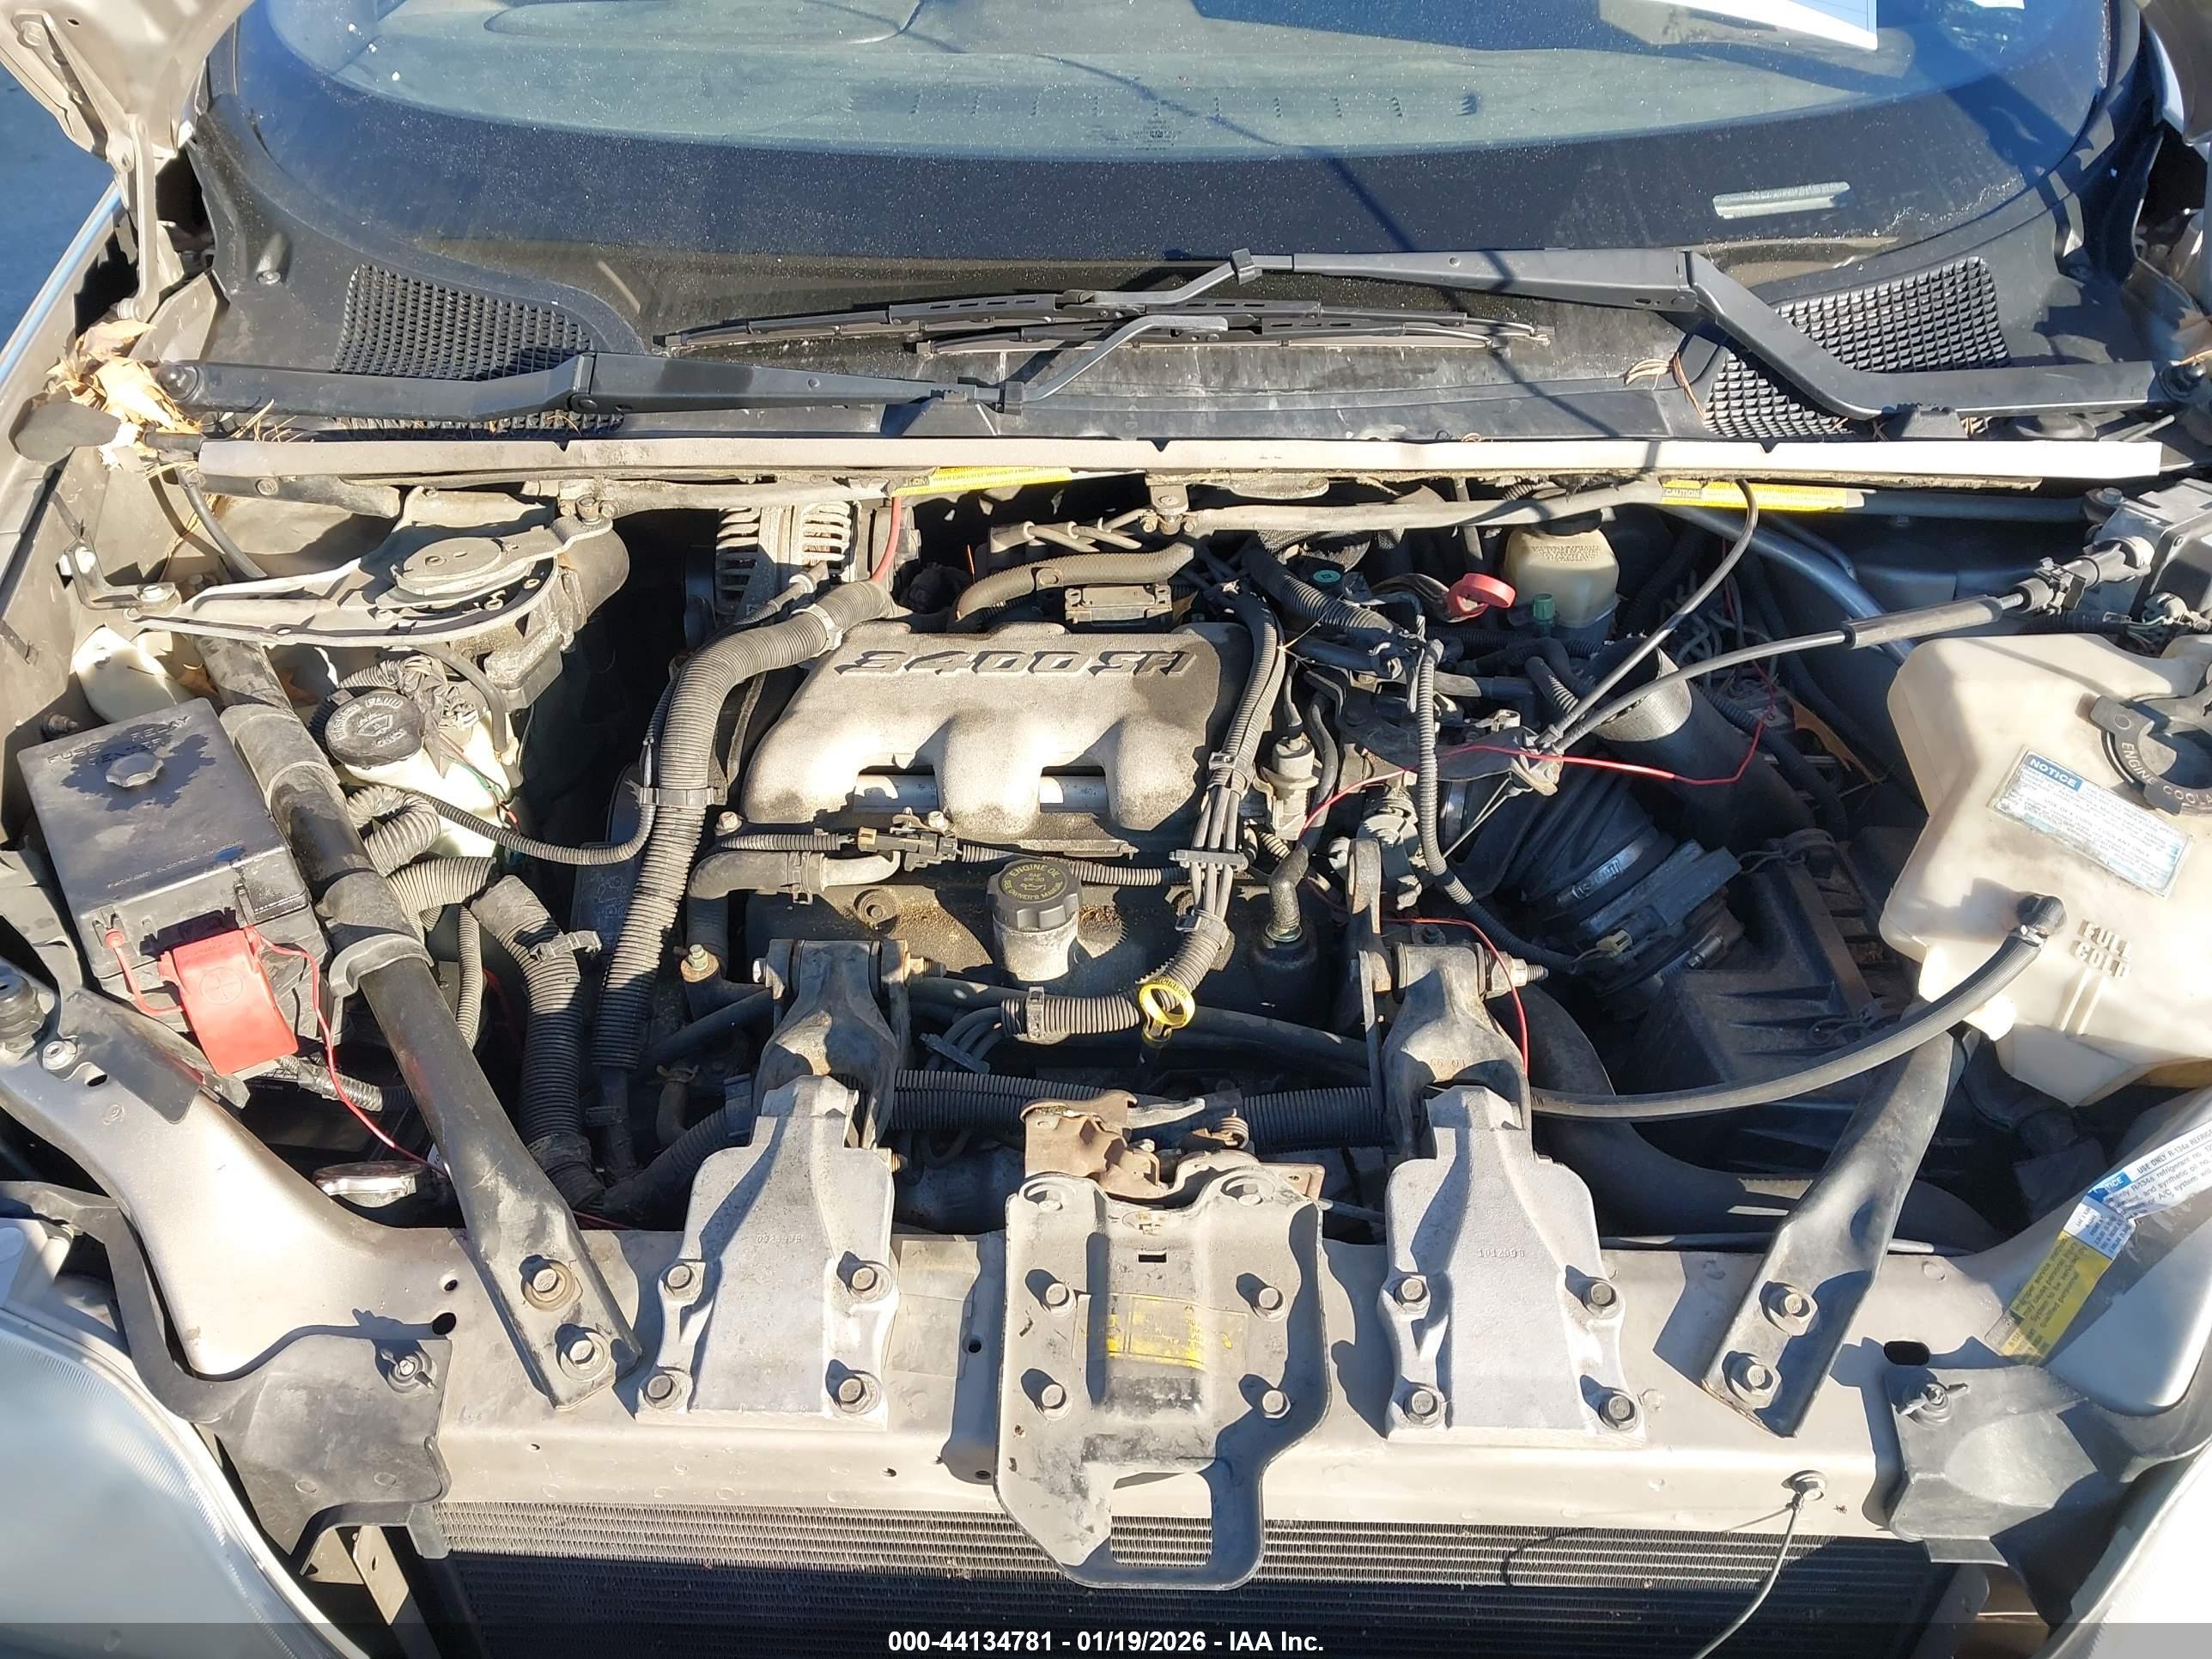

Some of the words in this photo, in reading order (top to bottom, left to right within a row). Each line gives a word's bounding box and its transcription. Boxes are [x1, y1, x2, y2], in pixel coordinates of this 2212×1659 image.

[1666, 488, 1700, 497] CAUTION
[46, 743, 101, 765] FUSE
[131, 714, 191, 742] RELAY
[2027, 757, 2078, 788] NOTICE
[2121, 741, 2159, 786] ENGINE
[1009, 864, 1048, 878] ENGINE
[1047, 867, 1061, 878] OIL
[2076, 919, 2132, 961] FULL
[2069, 940, 2132, 979] COLD
[2136, 1161, 2150, 1174] USE
[2149, 1152, 2167, 1167] ONLY
